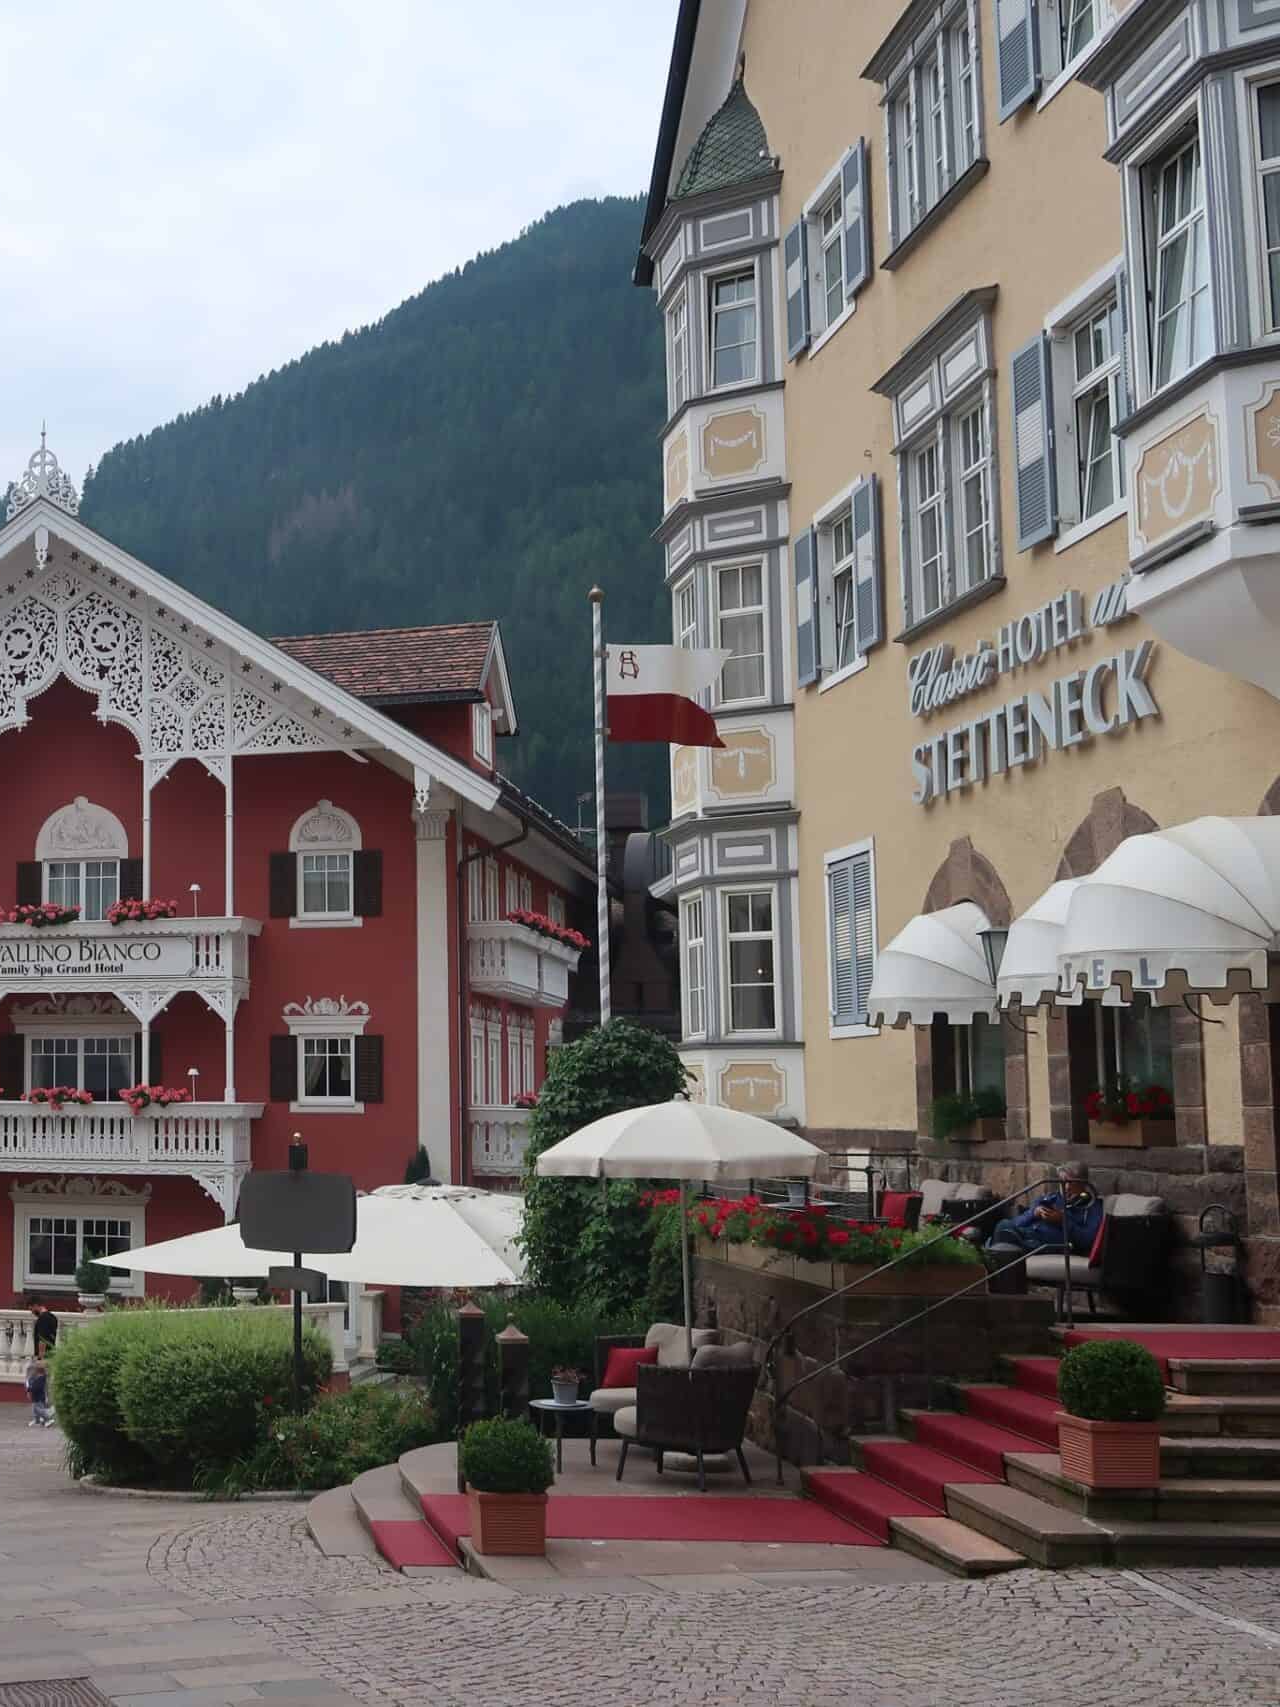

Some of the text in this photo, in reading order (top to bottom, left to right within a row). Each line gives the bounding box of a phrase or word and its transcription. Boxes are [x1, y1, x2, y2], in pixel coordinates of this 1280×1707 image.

[908, 640, 997, 716] Classic
[997, 590, 1082, 673] HOTEL
[912, 640, 1160, 806] STETTENECK
[33, 964, 53, 976] Spa
[56, 963, 92, 974] Grand
[95, 963, 124, 974] Hotel
[78, 939, 161, 962] BIANCO
